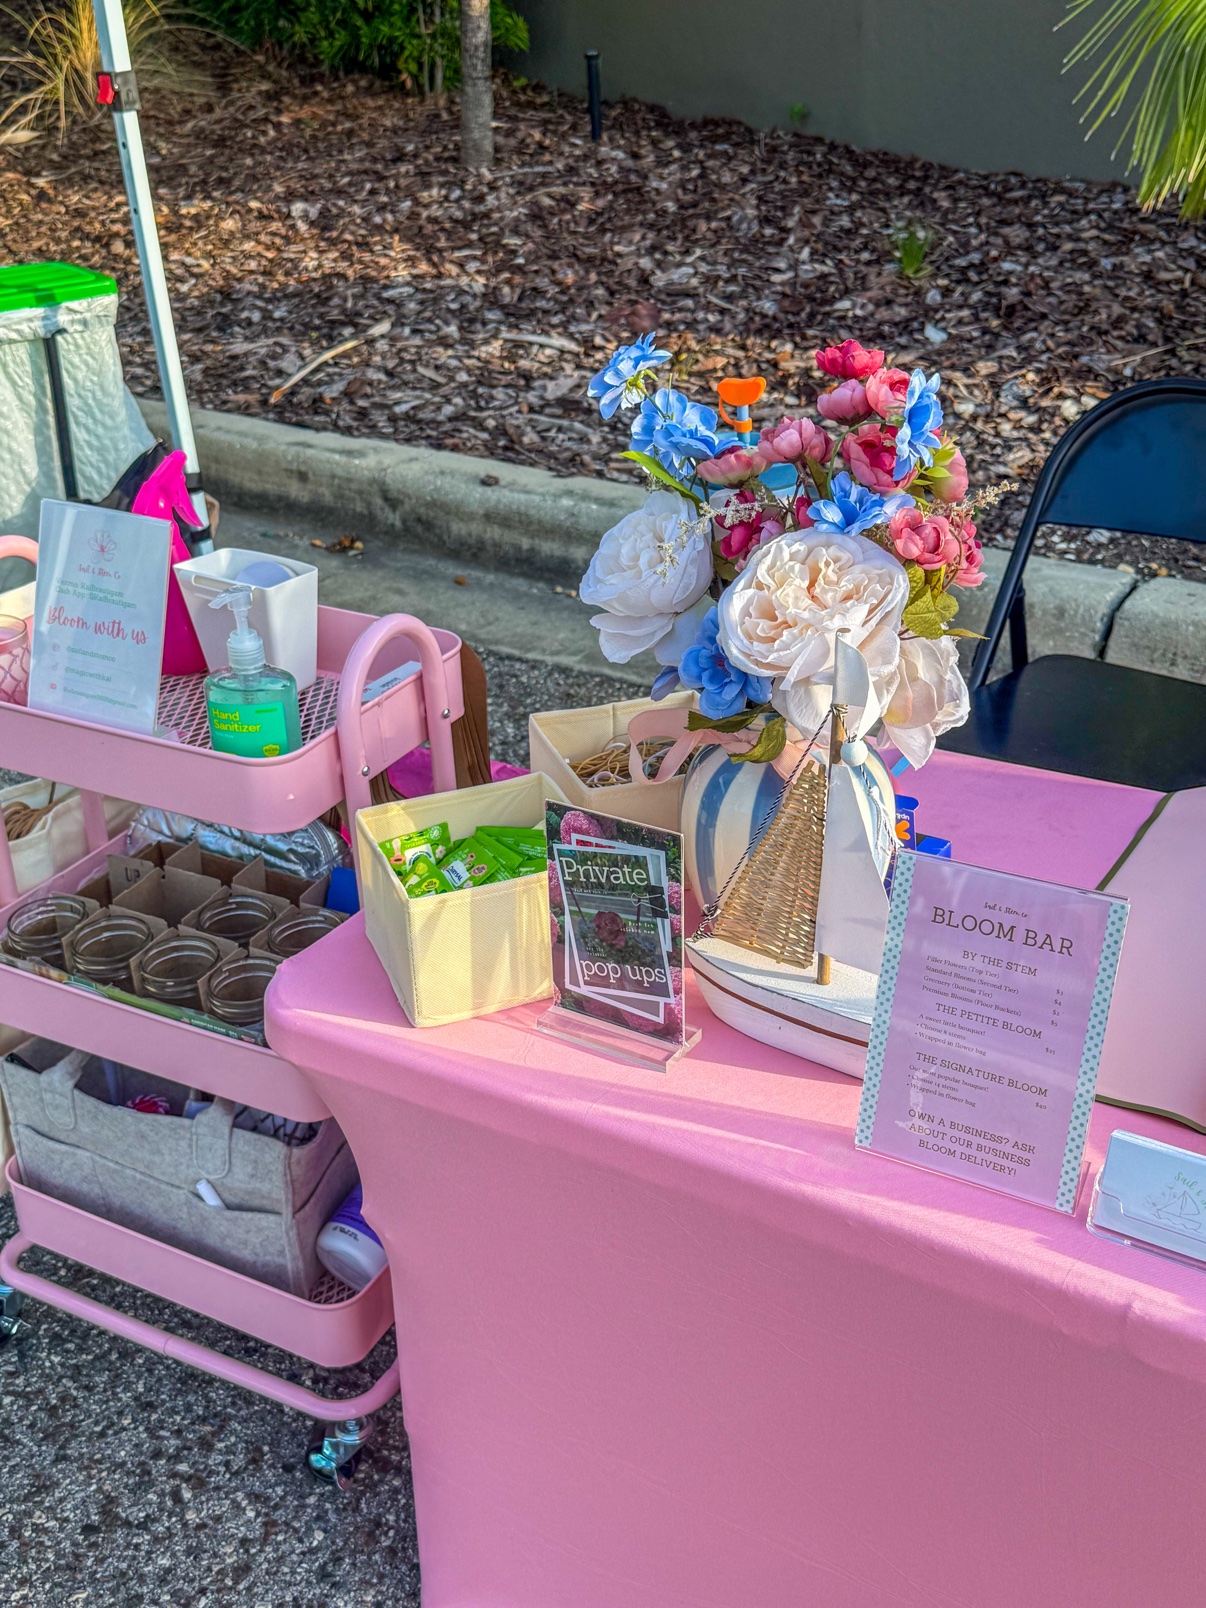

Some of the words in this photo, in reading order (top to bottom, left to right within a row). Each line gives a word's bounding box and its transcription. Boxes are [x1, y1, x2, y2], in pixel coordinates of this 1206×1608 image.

[46, 606, 90, 630] Bloom
[94, 619, 128, 640] with
[131, 628, 148, 645] us
[212, 708, 239, 721] Hand
[214, 719, 262, 733] Sanitizer
[560, 857, 648, 886] Private
[984, 902, 997, 911] Sail
[1004, 907, 1020, 916] Stem
[931, 906, 1016, 942] BLOOM
[1022, 928, 1074, 957] BAR
[580, 959, 621, 983] pop
[626, 964, 667, 987] ups
[927, 955, 942, 964] Filler
[944, 960, 967, 970] Flowers
[968, 966, 983, 975] (Top
[985, 970, 1000, 979] Tier)
[962, 950, 978, 961] BY
[980, 954, 1003, 968] THE
[1005, 962, 1038, 977] STEM
[923, 975, 950, 987] Greenery
[952, 982, 976, 994] (Bottom
[977, 990, 993, 999] Tier)
[925, 965, 952, 977] Standard
[954, 972, 976, 983] Blooms
[977, 979, 1002, 990] (Second
[1004, 985, 1019, 995] Tier)
[922, 985, 949, 997] Premium
[951, 992, 973, 1003] Blooms
[974, 999, 993, 1009] (Floor
[994, 1004, 1021, 1017] Buckets)
[920, 1022, 943, 1034] Choose
[948, 1032, 966, 1040] stems
[925, 1016, 942, 1024] sweet
[943, 1020, 957, 1028] little
[958, 1024, 986, 1036] bouquet!
[936, 1003, 957, 1016] THE
[960, 1009, 999, 1027] PETITE
[1002, 1021, 1042, 1039] BLOOM
[919, 1032, 946, 1044] Wrapped
[954, 1042, 974, 1052] flower
[975, 1048, 987, 1056] bag
[909, 1064, 920, 1072] Our
[922, 1069, 937, 1077] most
[937, 1073, 961, 1084] popular
[962, 1080, 989, 1092] bouquet!
[912, 1075, 934, 1085] Choose
[942, 1084, 959, 1092] stems
[916, 1052, 938, 1065] THE
[940, 1059, 1005, 1084] SIGNATURE
[1007, 1078, 1048, 1097] BLOOM
[910, 1082, 937, 1095] Wrapped
[946, 1093, 964, 1103] flower
[965, 1099, 976, 1107] bag
[1035, 1101, 1047, 1110] $40
[909, 1109, 935, 1123] OWN
[938, 1118, 946, 1127] A
[949, 1120, 1010, 1146] BUSINESS?
[1012, 1141, 1036, 1155] ASK
[909, 1123, 947, 1141] ABOUT
[950, 1135, 973, 1150] OUR
[976, 1143, 1031, 1167] BUSINESS
[918, 1139, 957, 1158] BLOOM
[959, 1152, 1017, 1177] DELIVERY!
[1174, 1171, 1198, 1190] Sail
